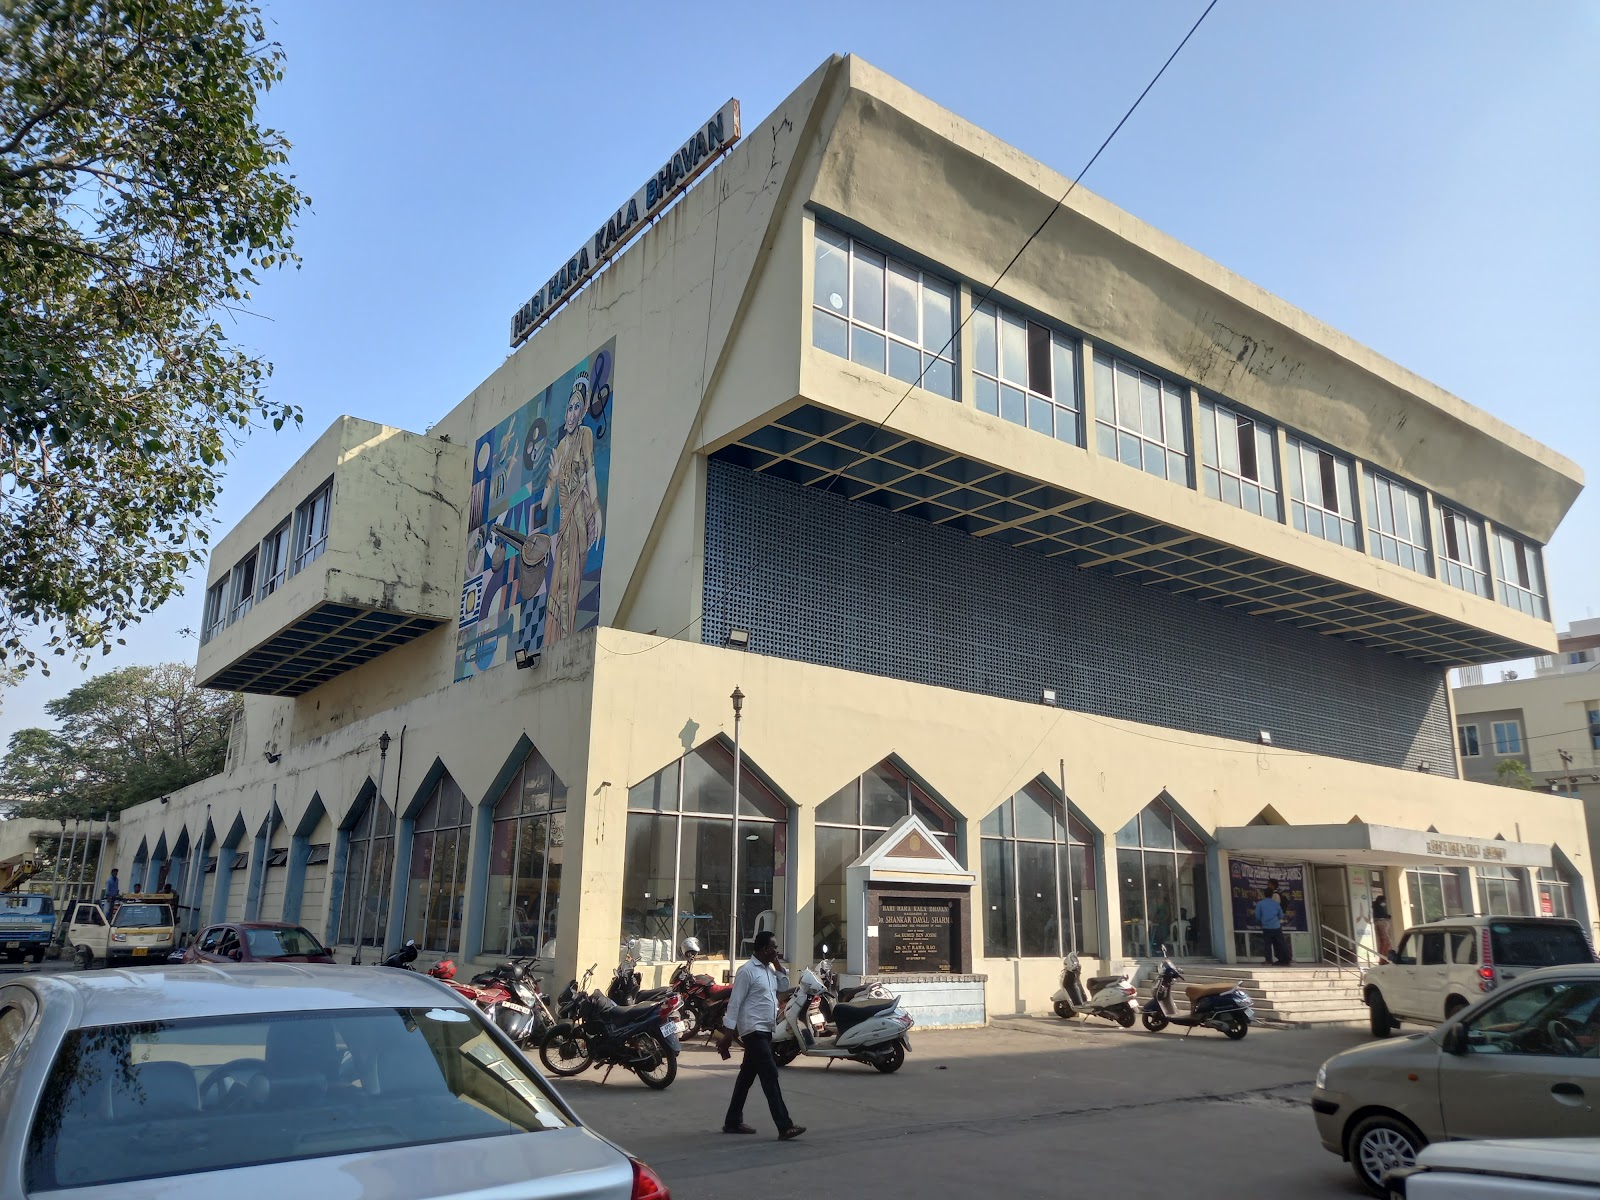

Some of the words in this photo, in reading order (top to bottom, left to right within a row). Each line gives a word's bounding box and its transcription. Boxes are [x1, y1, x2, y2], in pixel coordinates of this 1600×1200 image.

[513, 288, 546, 338] HARI
[548, 246, 590, 305] HARA
[594, 198, 639, 259] KALA
[646, 112, 726, 210] BHAVAN
[885, 916, 912, 924] SHANKAR
[913, 916, 930, 924] DAYAL
